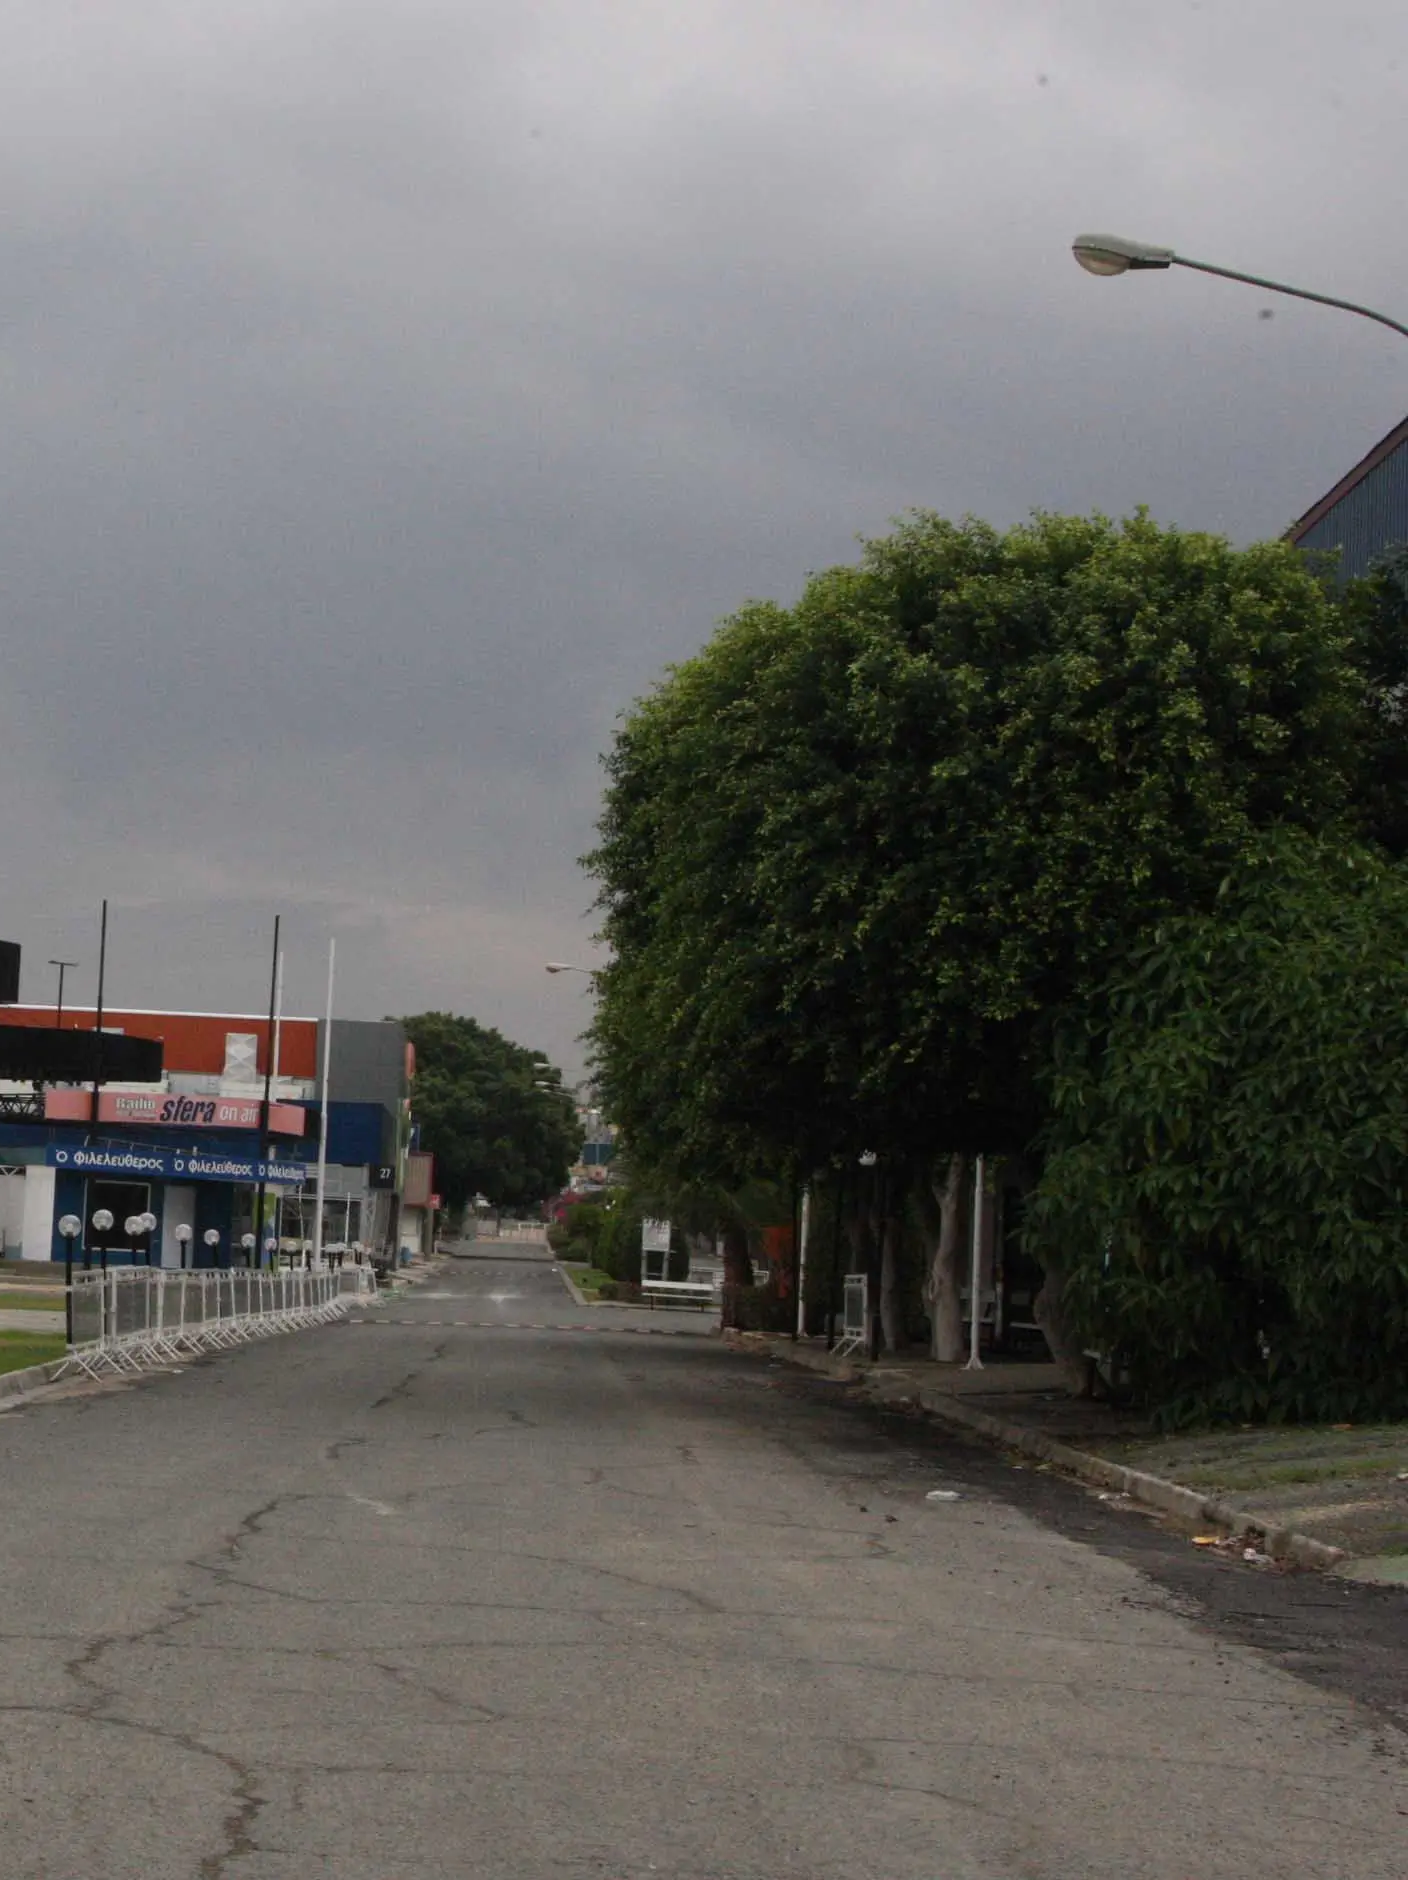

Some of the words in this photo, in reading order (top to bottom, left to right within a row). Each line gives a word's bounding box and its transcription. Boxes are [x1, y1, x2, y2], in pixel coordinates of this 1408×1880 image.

[160, 1096, 216, 1123] sfera
[220, 1105, 238, 1121] on
[242, 1104, 259, 1122] air
[379, 1168, 391, 1179] 27
